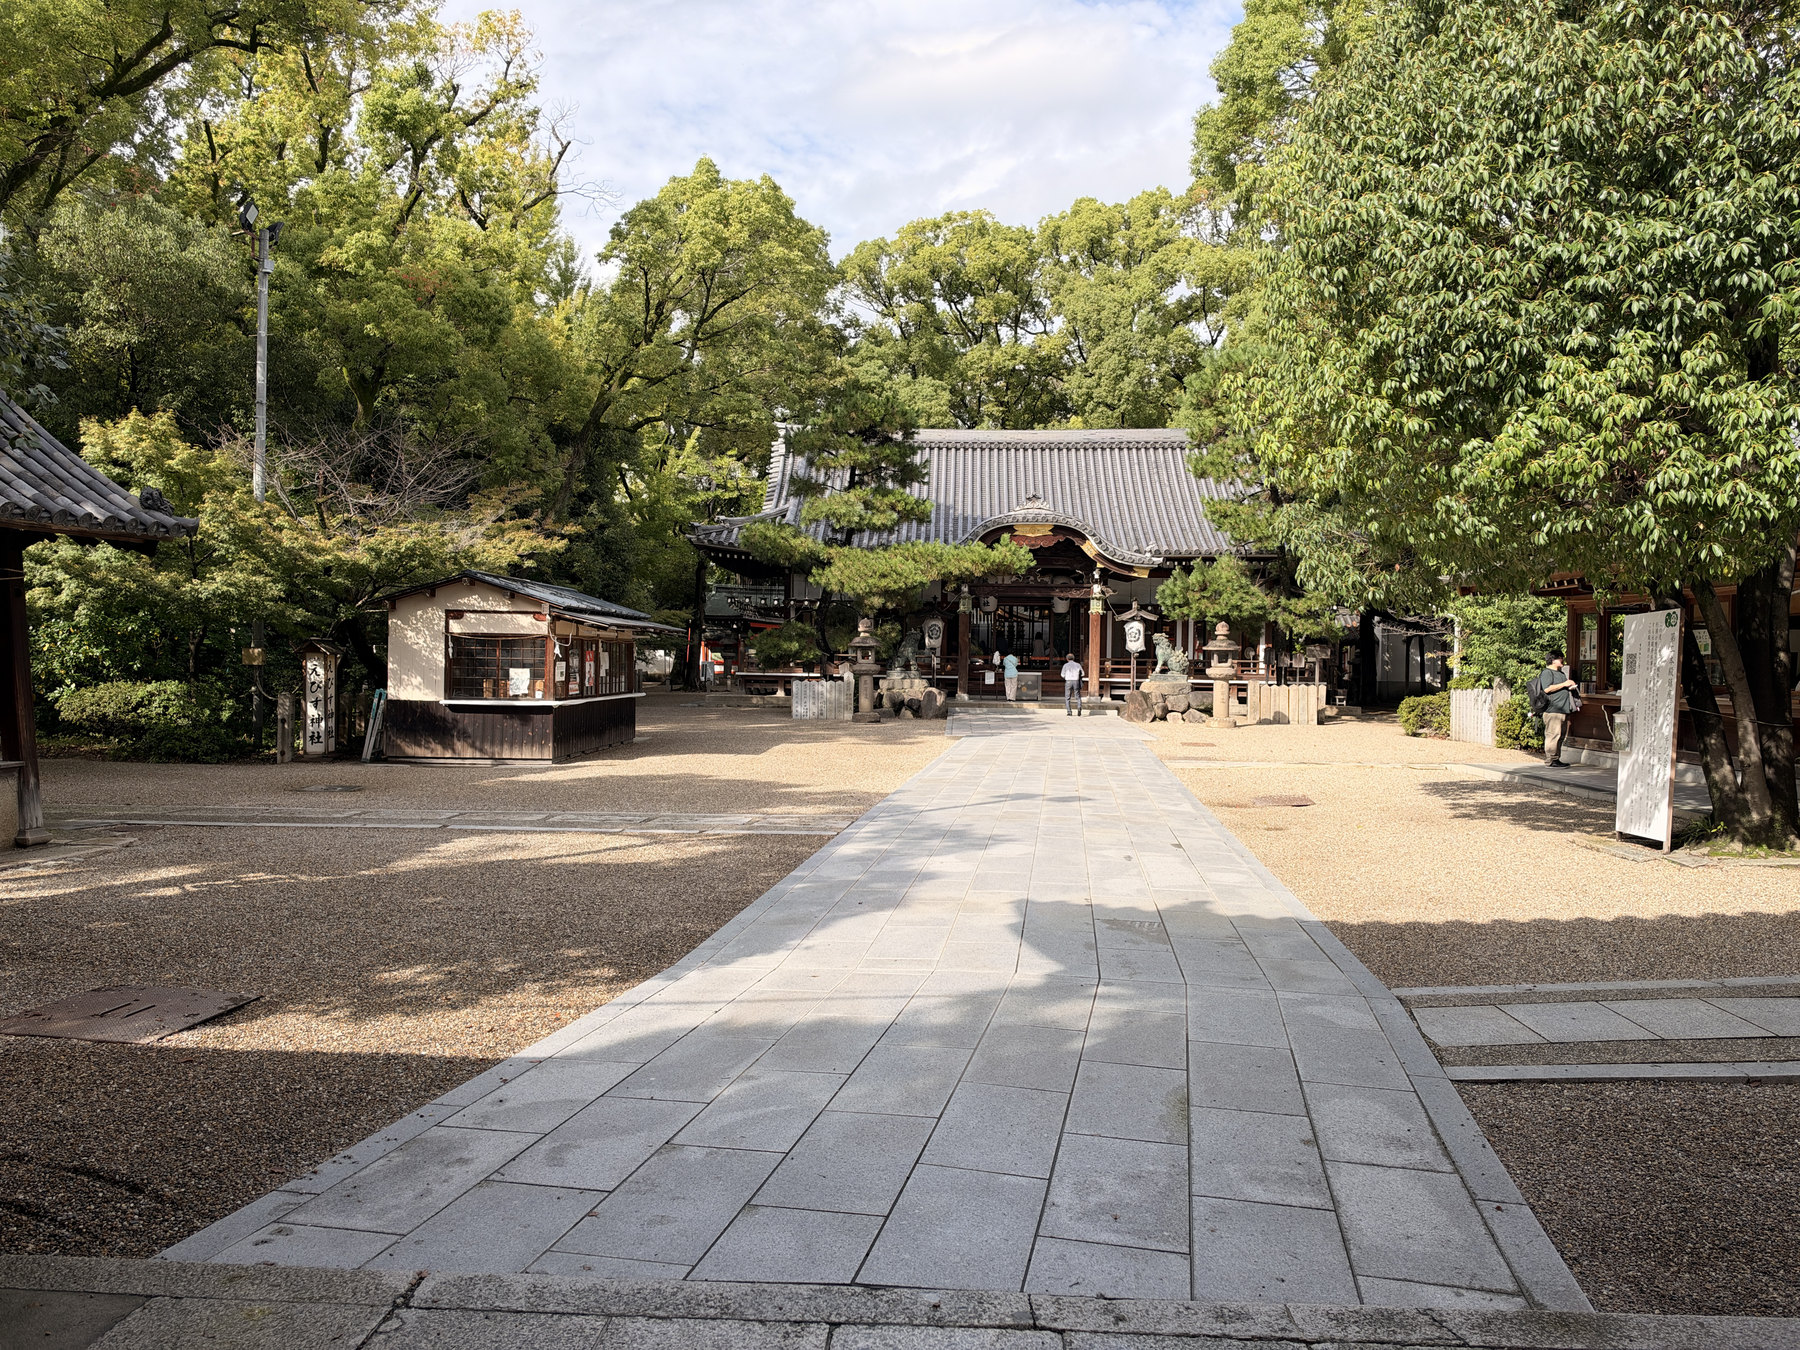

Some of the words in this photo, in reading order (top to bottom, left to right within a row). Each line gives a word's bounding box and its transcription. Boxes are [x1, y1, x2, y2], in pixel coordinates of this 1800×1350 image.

[309, 663, 324, 746] えびす神社
